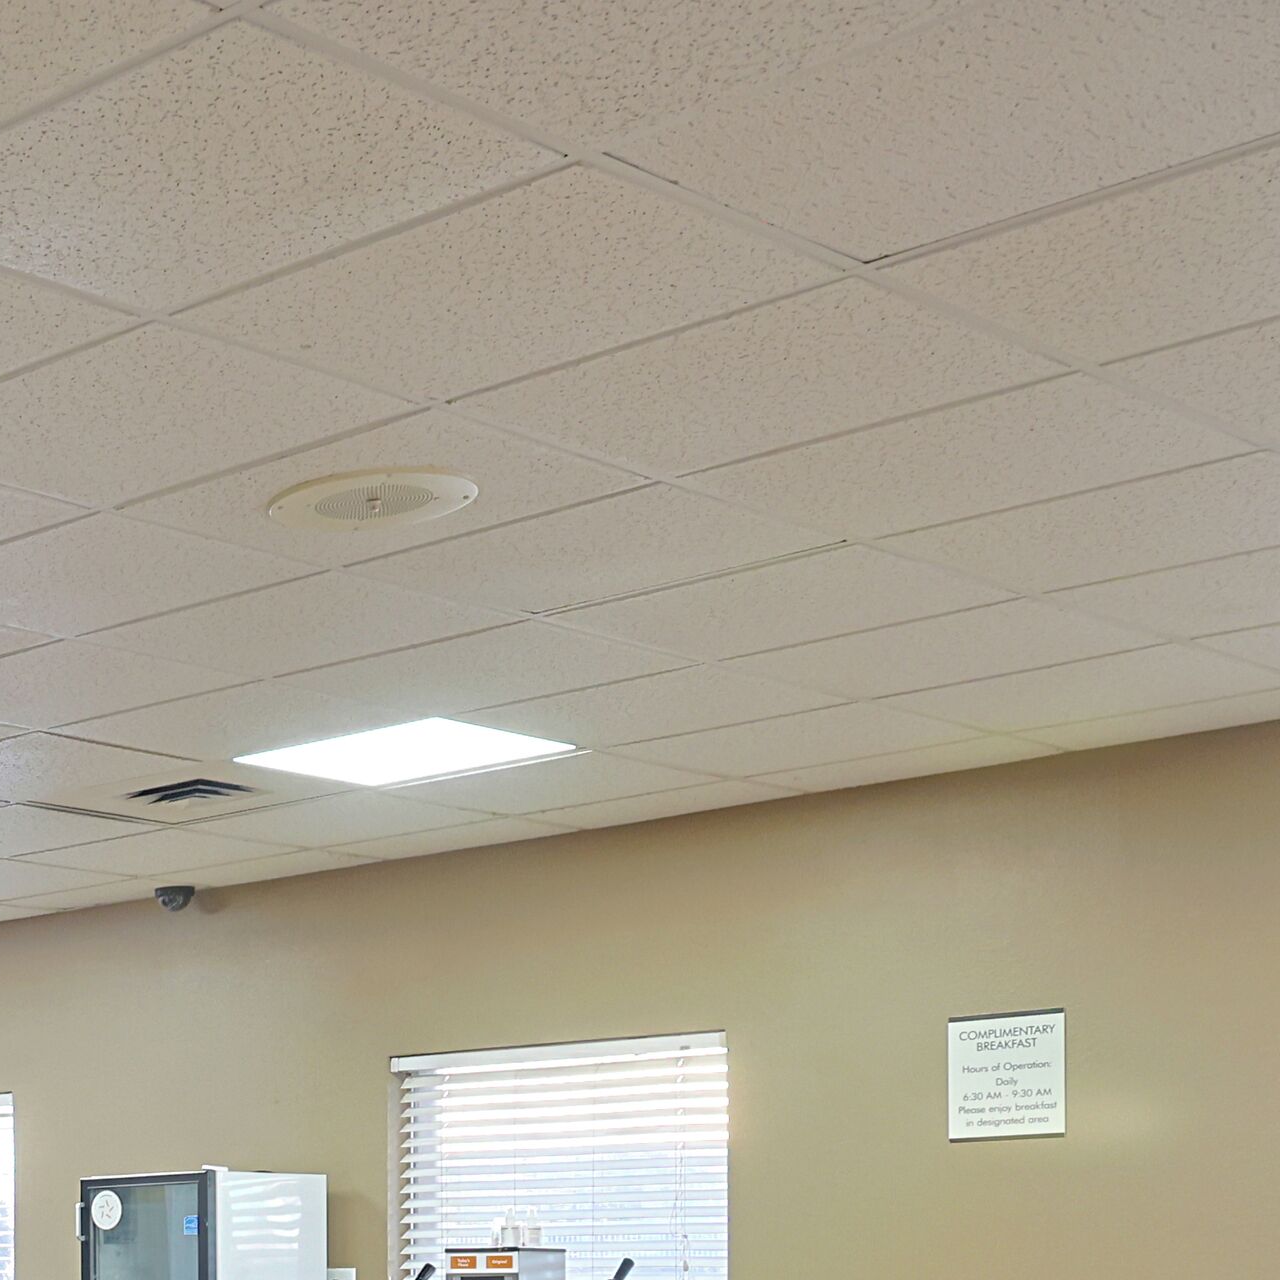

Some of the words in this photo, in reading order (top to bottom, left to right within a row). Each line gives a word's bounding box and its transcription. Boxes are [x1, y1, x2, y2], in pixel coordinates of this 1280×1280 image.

[959, 1024, 1056, 1041] COMPLIMENTARY
[976, 1038, 1037, 1052] BREAKFAST
[962, 1065, 988, 1074] Hours
[991, 1063, 1001, 1072] of
[995, 1077, 1018, 1086] Daily
[963, 1092, 983, 1101] 6:30
[986, 1091, 1002, 1099] AM
[1012, 1089, 1033, 1098] 9:30
[1036, 1088, 1052, 1096] AM
[958, 1106, 986, 1114] Please
[988, 1104, 1012, 1113] enjoy
[1015, 1101, 1057, 1112] breakfast
[966, 1119, 974, 1127] in
[977, 1116, 1025, 1127] designated
[1028, 1116, 1049, 1124] area
